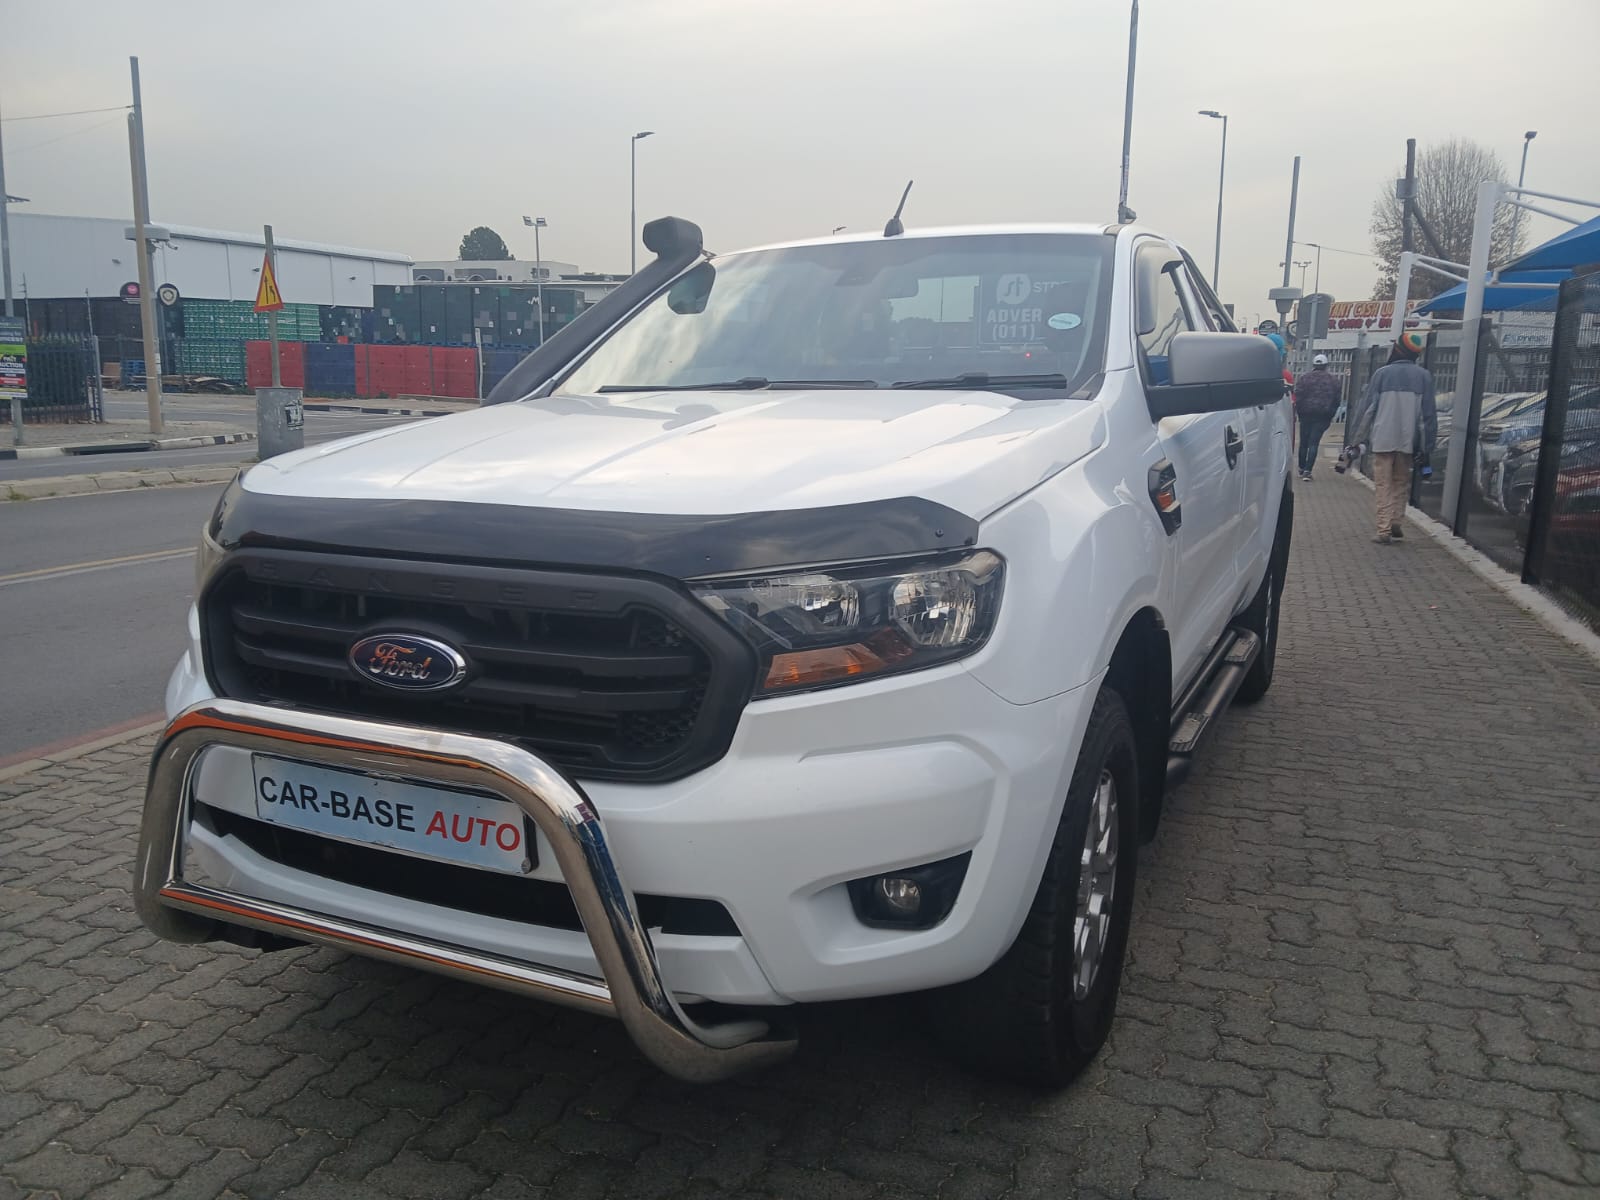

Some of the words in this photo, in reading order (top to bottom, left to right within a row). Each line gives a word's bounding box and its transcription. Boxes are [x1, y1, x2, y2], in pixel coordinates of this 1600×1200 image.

[987, 309, 1042, 323] ADVER
[1353, 302, 1380, 317] CASH
[992, 323, 1035, 341] (011)
[259, 557, 598, 610] RANGER
[368, 642, 432, 679] Ford
[259, 776, 416, 832] CAR-BASE
[425, 810, 521, 851] AUTO
